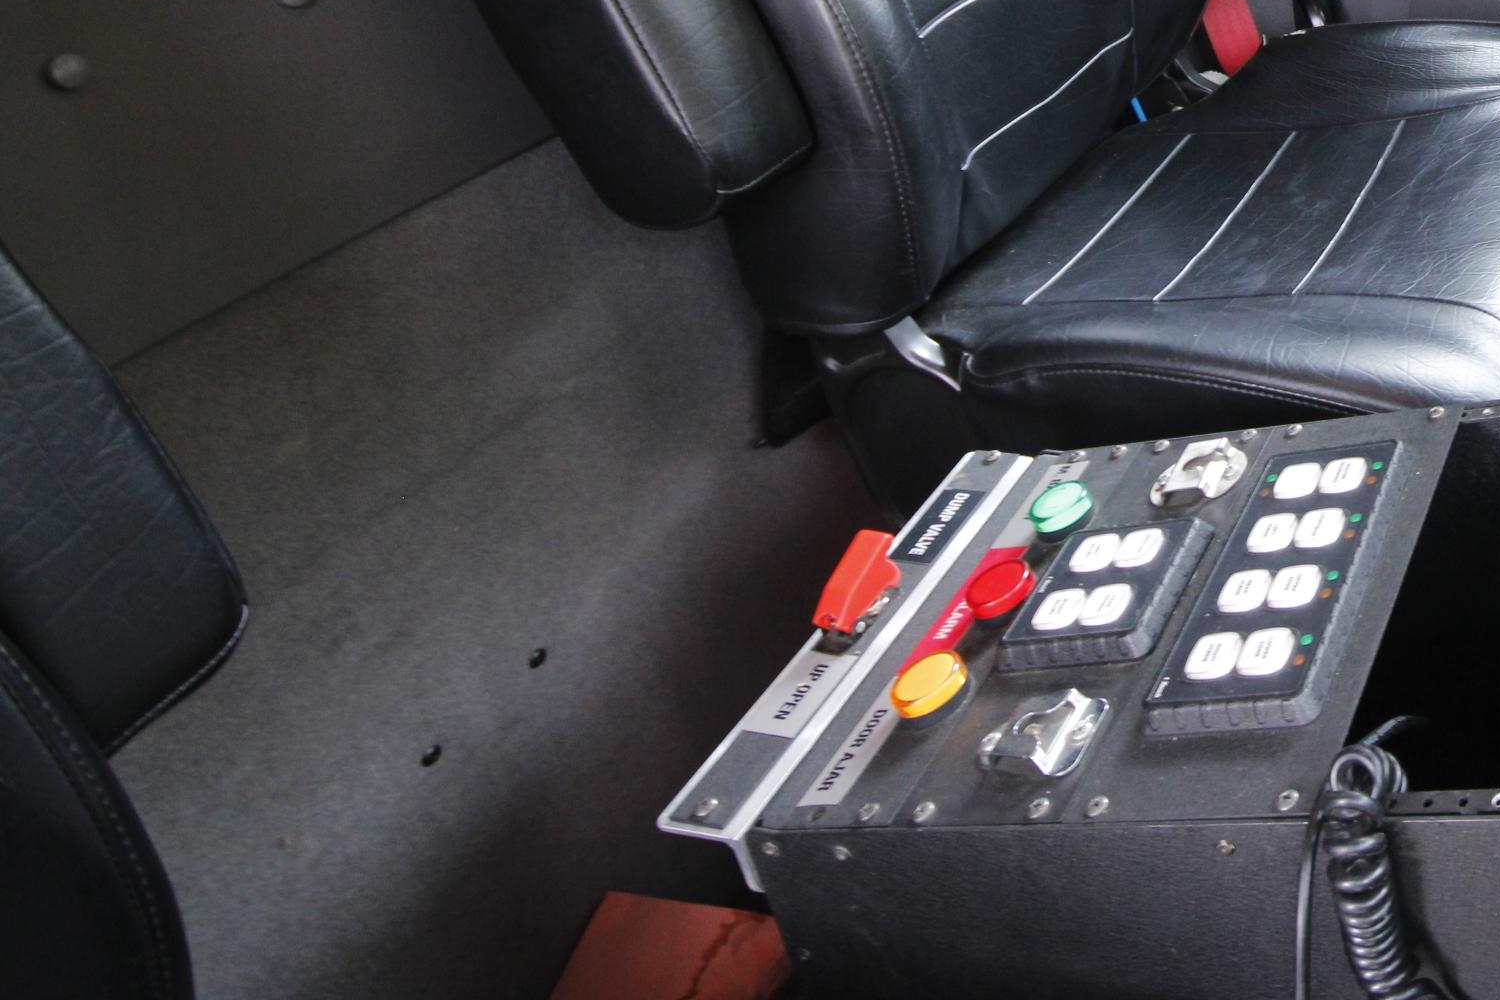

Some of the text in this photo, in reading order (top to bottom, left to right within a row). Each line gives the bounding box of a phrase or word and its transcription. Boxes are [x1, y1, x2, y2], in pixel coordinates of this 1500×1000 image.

[907, 491, 971, 557] DUMP VALVE
[773, 664, 830, 720] UP OPEN
[817, 709, 888, 791] DOOR AJAR
